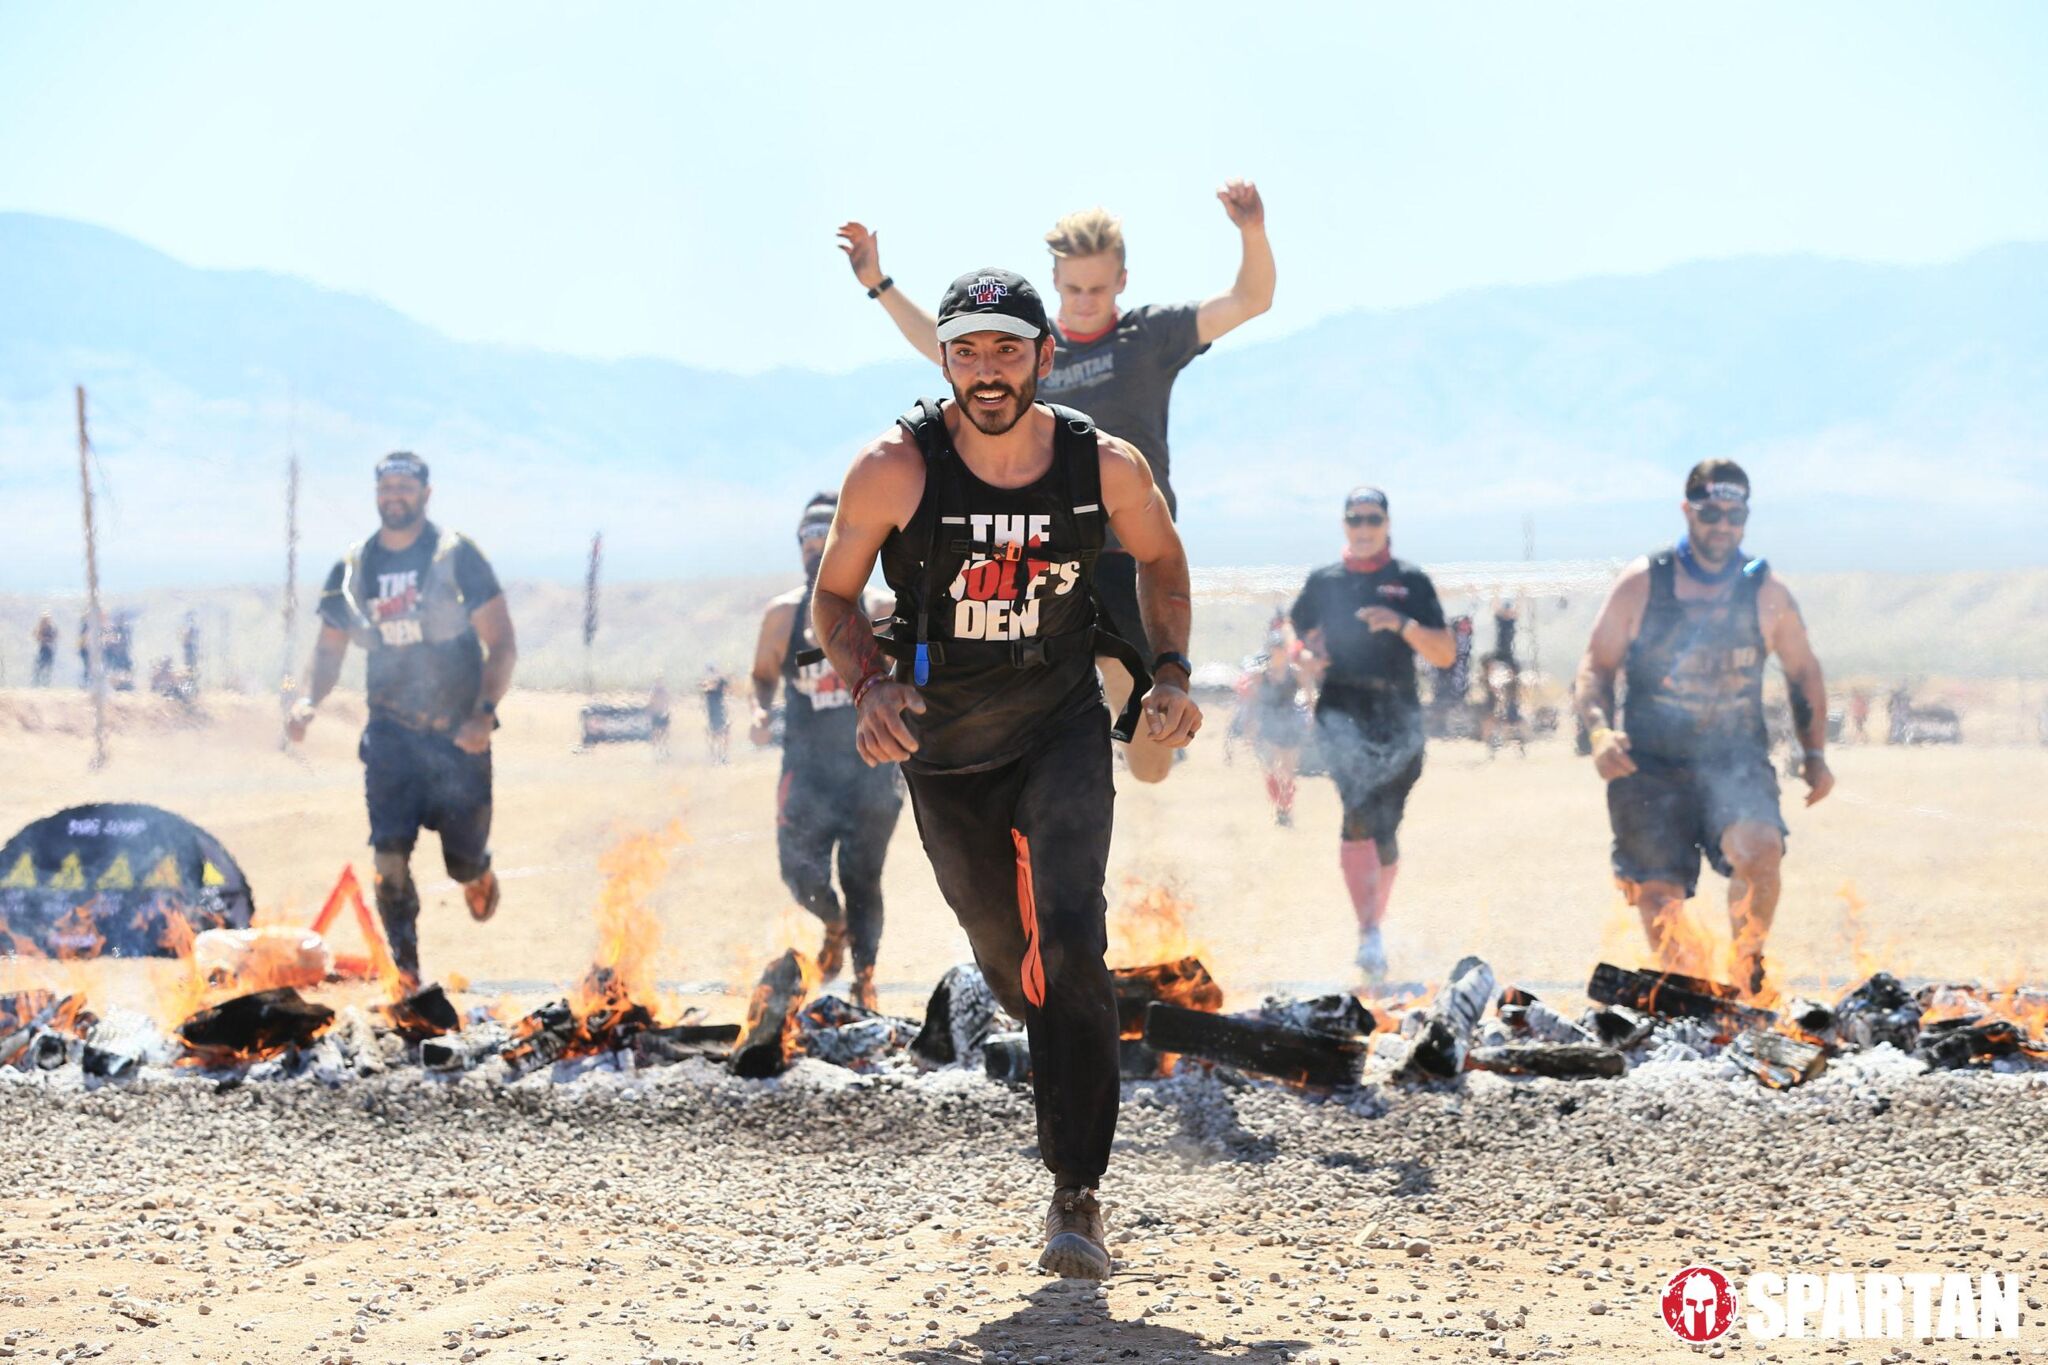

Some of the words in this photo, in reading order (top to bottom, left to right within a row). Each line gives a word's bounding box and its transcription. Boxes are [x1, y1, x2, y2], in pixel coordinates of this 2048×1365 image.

[968, 283, 1007, 296] WOLF'S
[976, 293, 999, 304] DEN
[970, 514, 1051, 561] THE
[954, 598, 1041, 642] DEN
